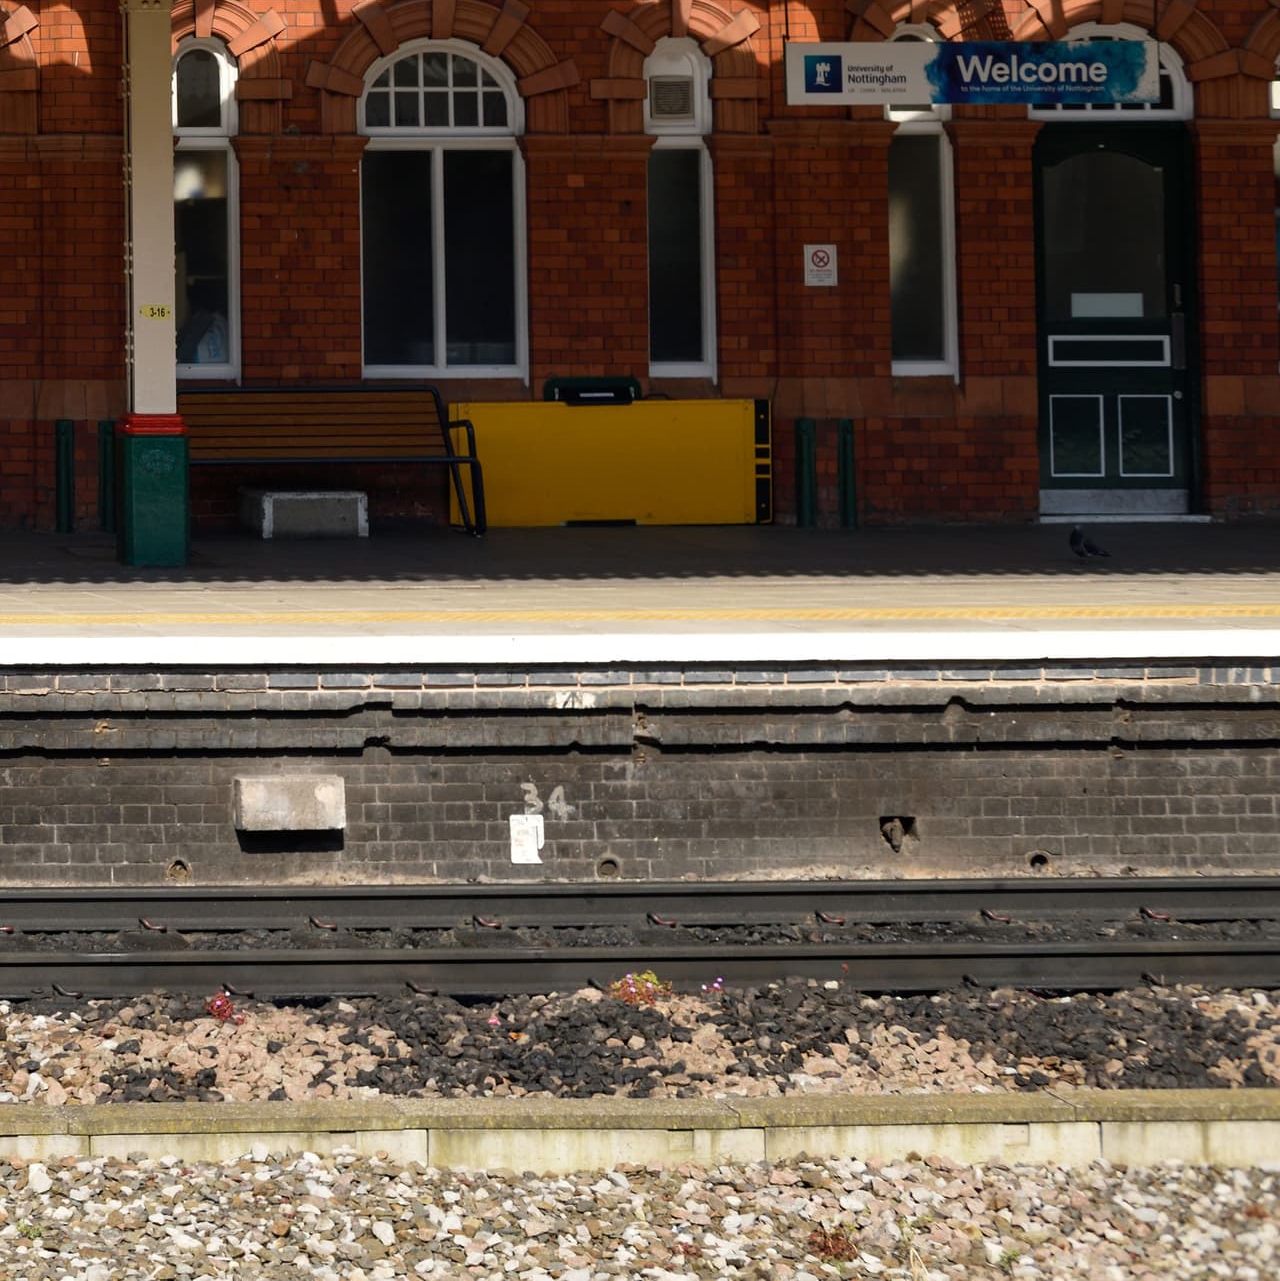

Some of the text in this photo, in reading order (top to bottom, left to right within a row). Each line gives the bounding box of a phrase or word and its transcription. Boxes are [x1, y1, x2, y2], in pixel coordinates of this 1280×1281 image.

[847, 65, 885, 74] University
[956, 54, 1108, 84] Welcome
[847, 73, 907, 86] Nottingham
[150, 307, 166, 318] 3-16
[520, 782, 576, 823] 34
